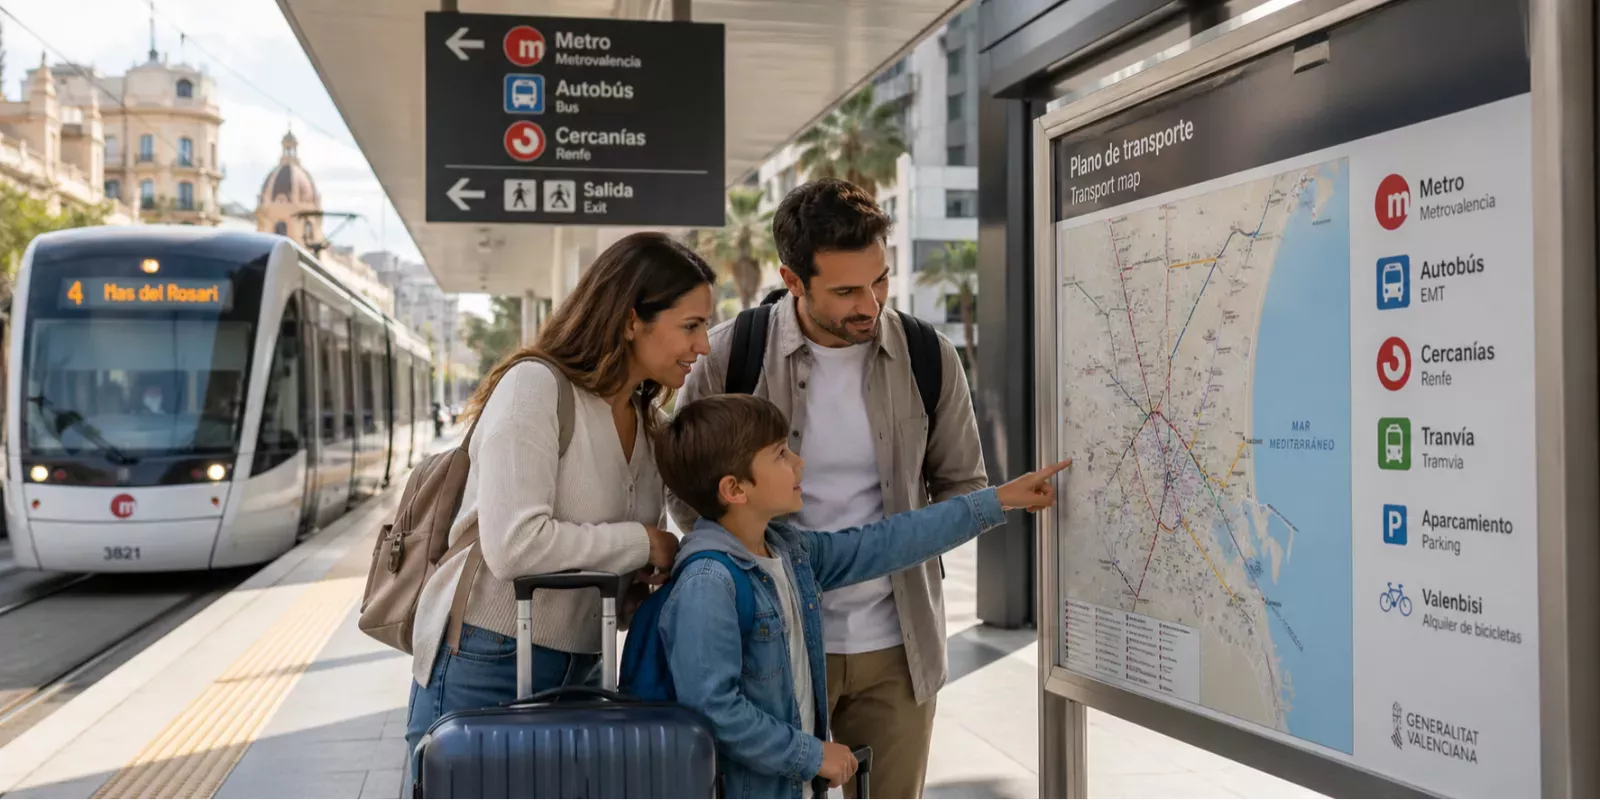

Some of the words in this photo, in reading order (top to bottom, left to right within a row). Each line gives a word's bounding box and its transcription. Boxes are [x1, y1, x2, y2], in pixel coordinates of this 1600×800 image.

[555, 31, 611, 50] Metro
[555, 53, 642, 68] Metrovalencia
[555, 80, 634, 99] Autobús
[555, 100, 579, 114] Bus
[555, 127, 646, 146] Cercanías
[556, 148, 591, 161] Renfe
[1070, 153, 1102, 179] Plano
[1105, 142, 1120, 167] de
[1123, 119, 1194, 156] transporte
[583, 182, 633, 199] Salida
[1070, 176, 1115, 205] Transport
[1118, 170, 1141, 192] map
[1420, 175, 1464, 198] Metro
[583, 201, 607, 214] Exit
[1420, 193, 1496, 221] Metrovalencia
[1420, 253, 1484, 280] Autobús
[67, 280, 83, 305] 4
[138, 283, 164, 302] del
[167, 283, 219, 302] Rosari
[1420, 285, 1445, 303] EMT
[1421, 341, 1495, 363] Cercanías
[1421, 370, 1452, 386] Renfe
[1291, 420, 1311, 432] MAR
[1421, 426, 1474, 446] Tranvía
[1388, 510, 1402, 537] P
[1422, 509, 1513, 535] Aparcamiento
[103, 546, 141, 561] 3821
[1422, 534, 1461, 556] Parking
[1422, 588, 1482, 615] Valenbisi
[1423, 613, 1457, 632] Alquiler
[1460, 620, 1472, 635] de
[1475, 623, 1522, 644] bicicletas
[1406, 712, 1479, 746] GENERALITAT
[1407, 730, 1478, 765] VALENCIANA
